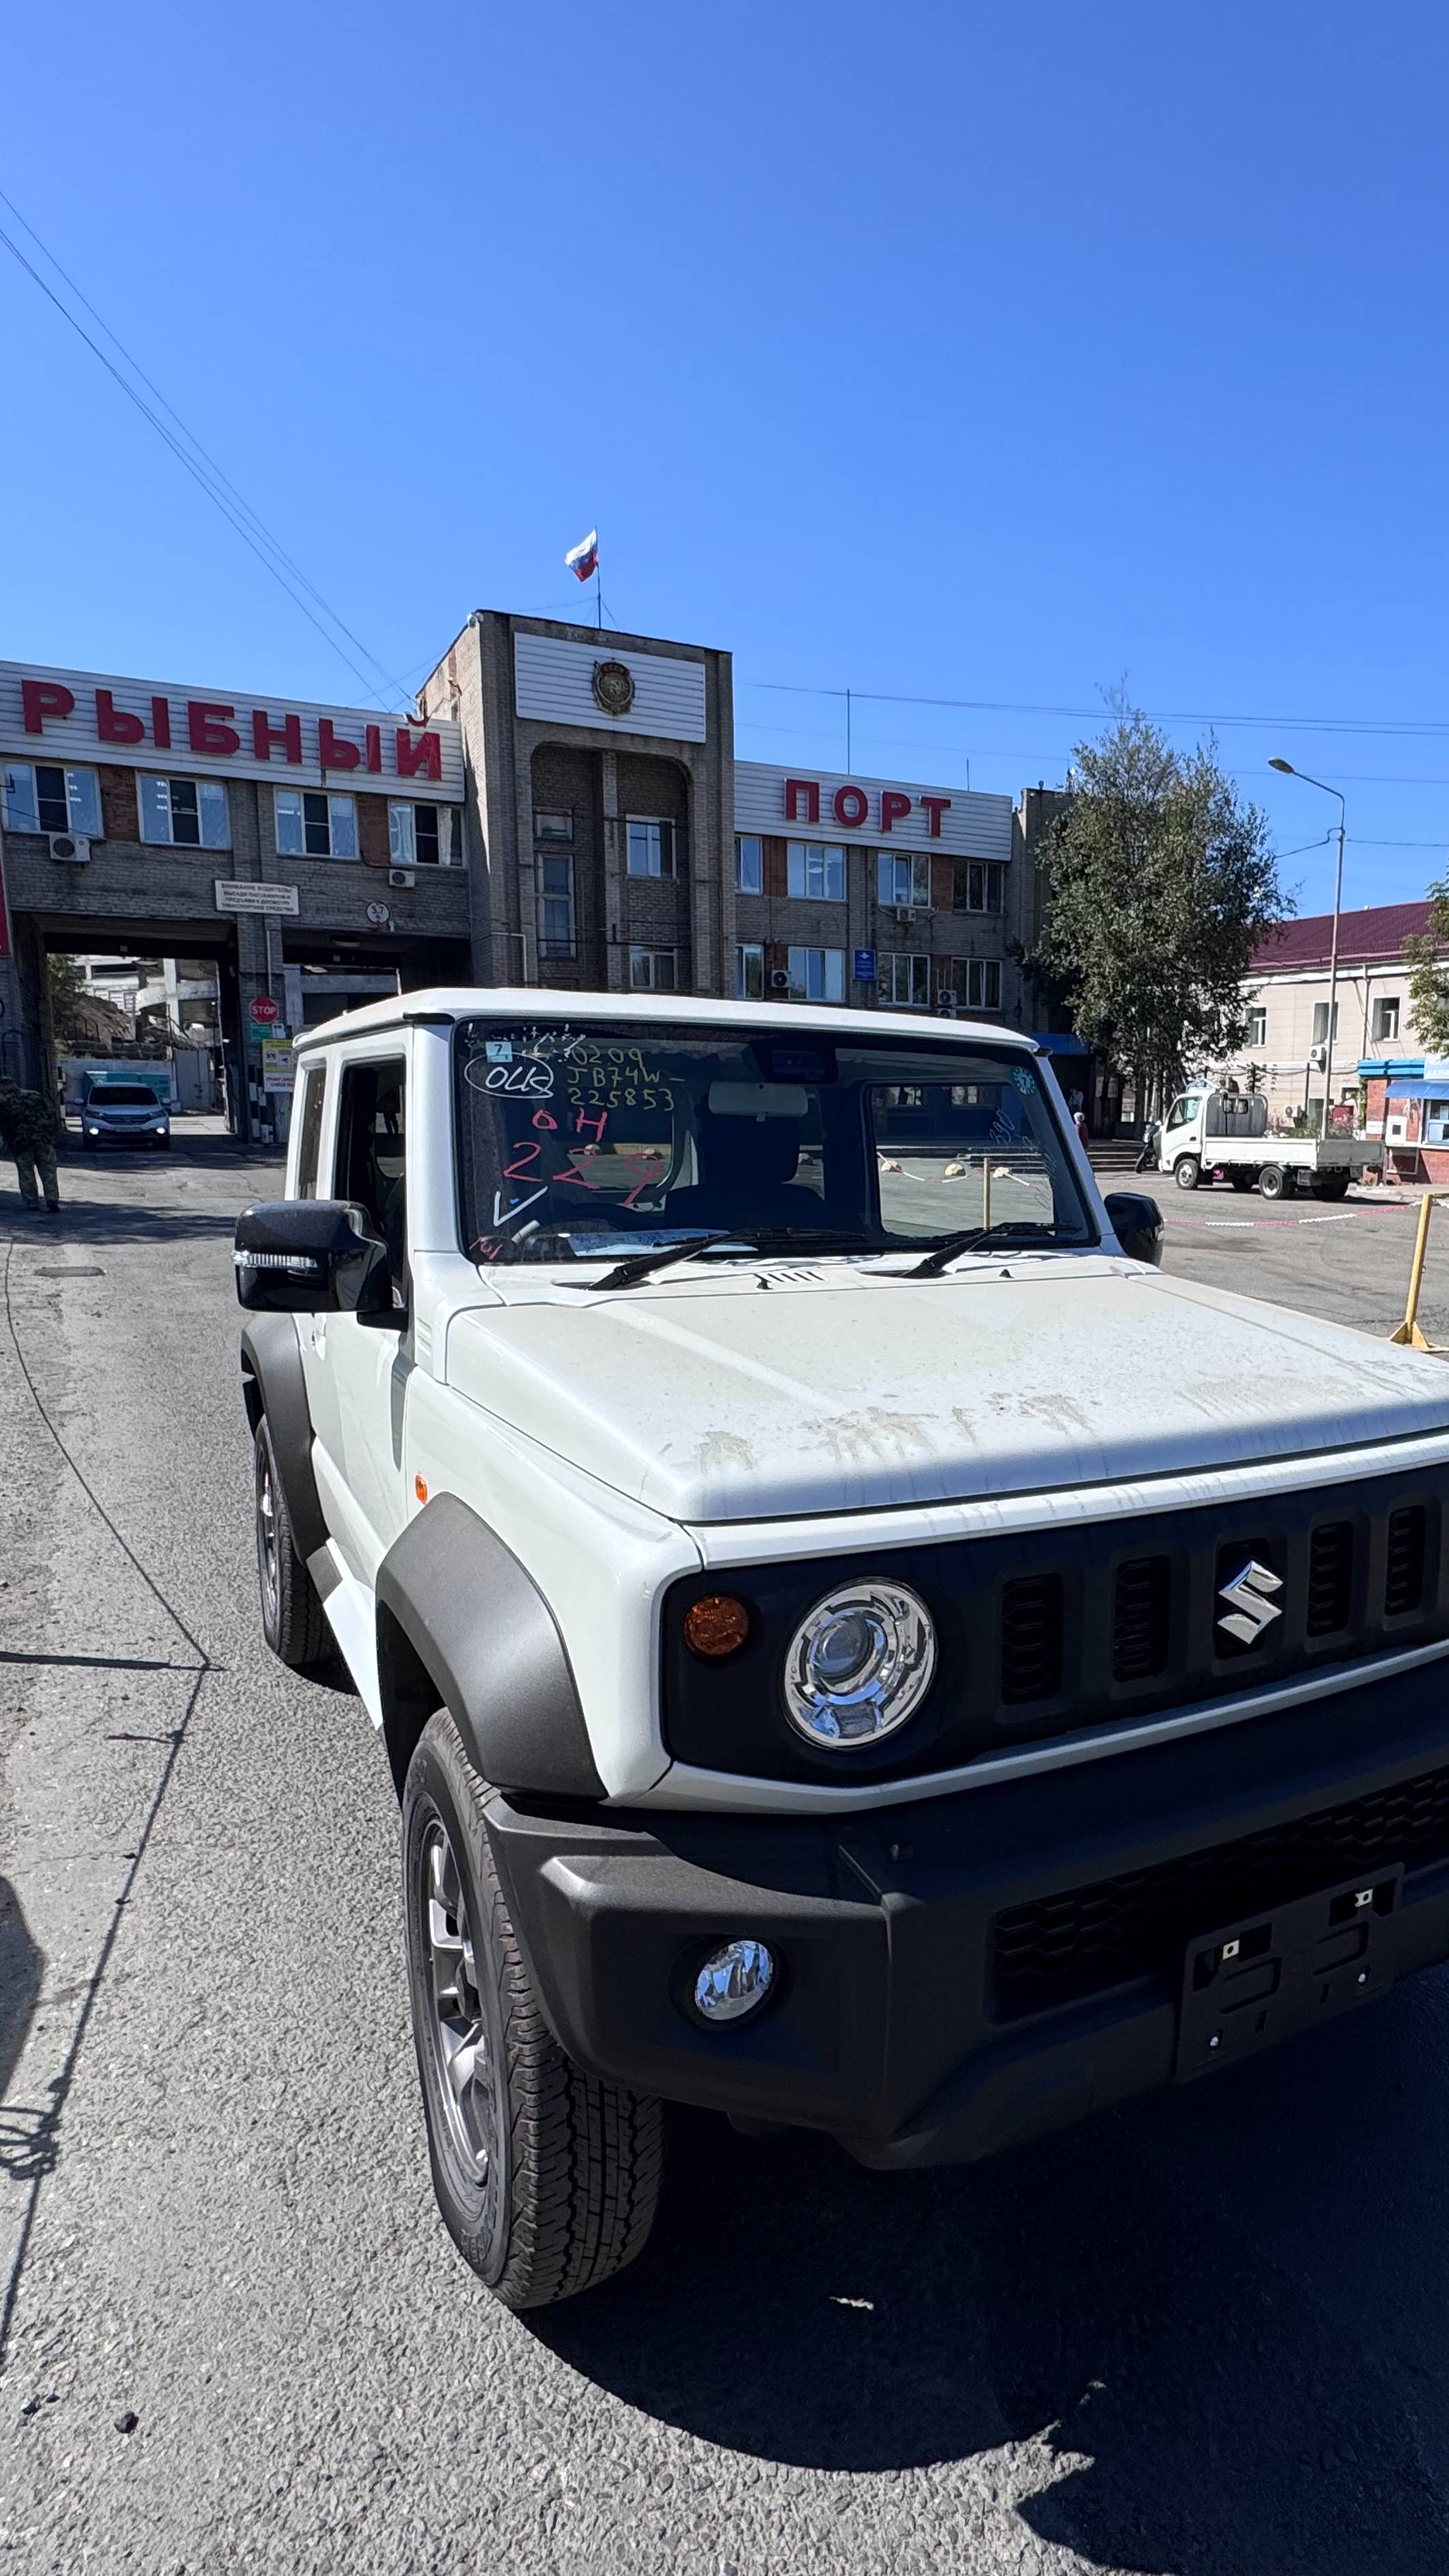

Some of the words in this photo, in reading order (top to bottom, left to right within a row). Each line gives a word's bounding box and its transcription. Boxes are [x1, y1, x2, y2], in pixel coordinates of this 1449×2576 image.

[20, 679, 442, 781] РЫБНЫЙ
[784, 778, 951, 838] ПОРТ
[251, 1005, 277, 1015] STOP
[568, 1087, 675, 1111] 225853
